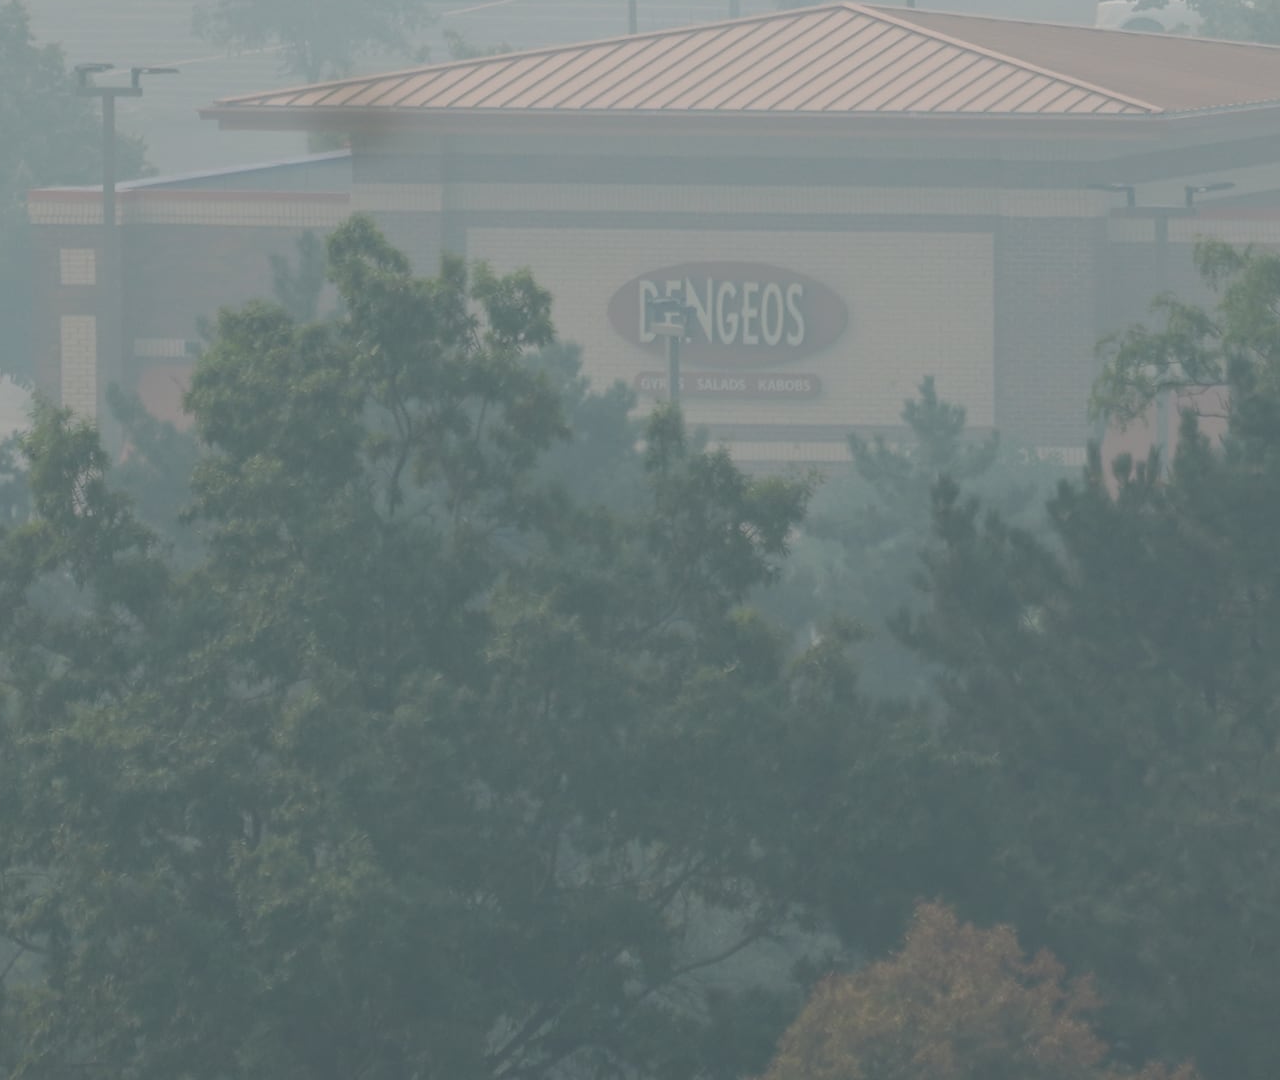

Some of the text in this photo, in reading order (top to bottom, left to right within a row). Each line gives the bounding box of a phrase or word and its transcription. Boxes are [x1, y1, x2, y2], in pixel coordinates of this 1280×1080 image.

[640, 376, 811, 392] GYRS SALADS KABOBS
